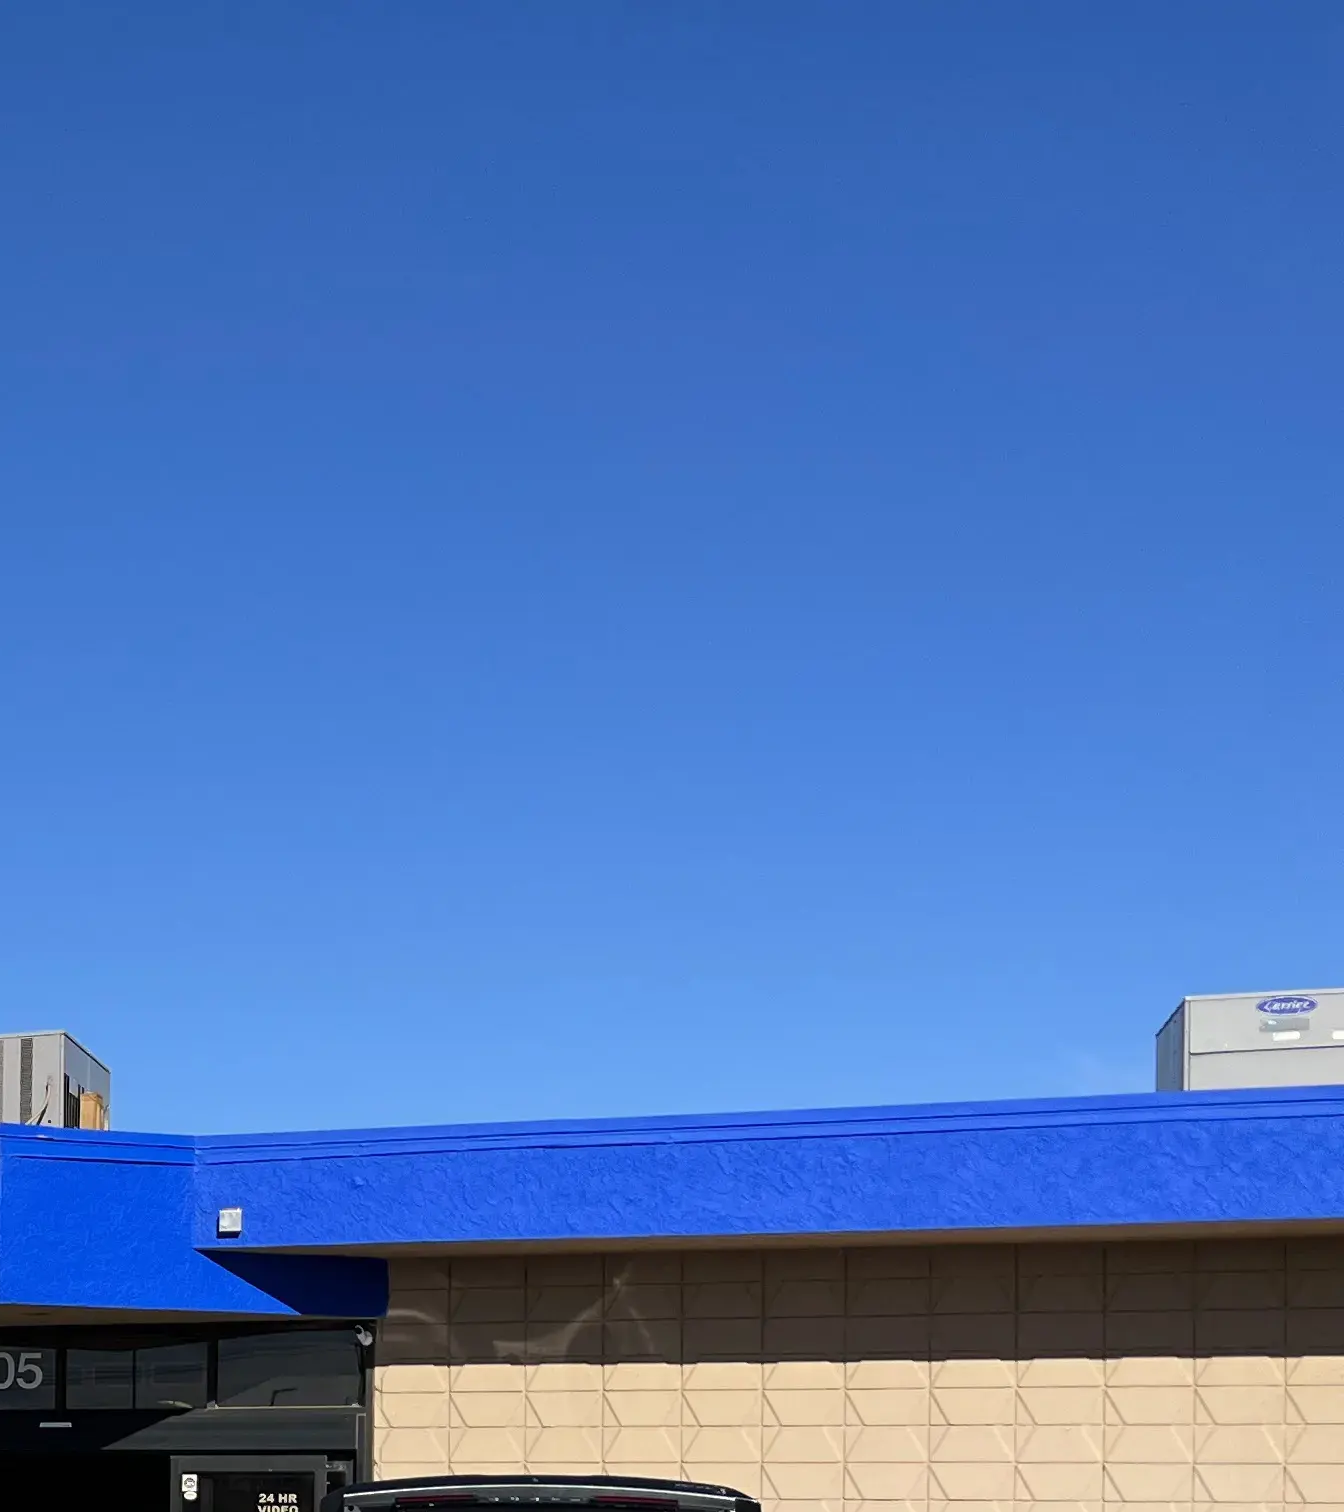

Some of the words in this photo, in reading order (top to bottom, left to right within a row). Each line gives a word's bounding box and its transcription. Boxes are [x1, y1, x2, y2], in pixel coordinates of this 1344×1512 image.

[1263, 999, 1312, 1014] Carrier
[259, 1493, 275, 1503] 24
[278, 1493, 298, 1503] HR
